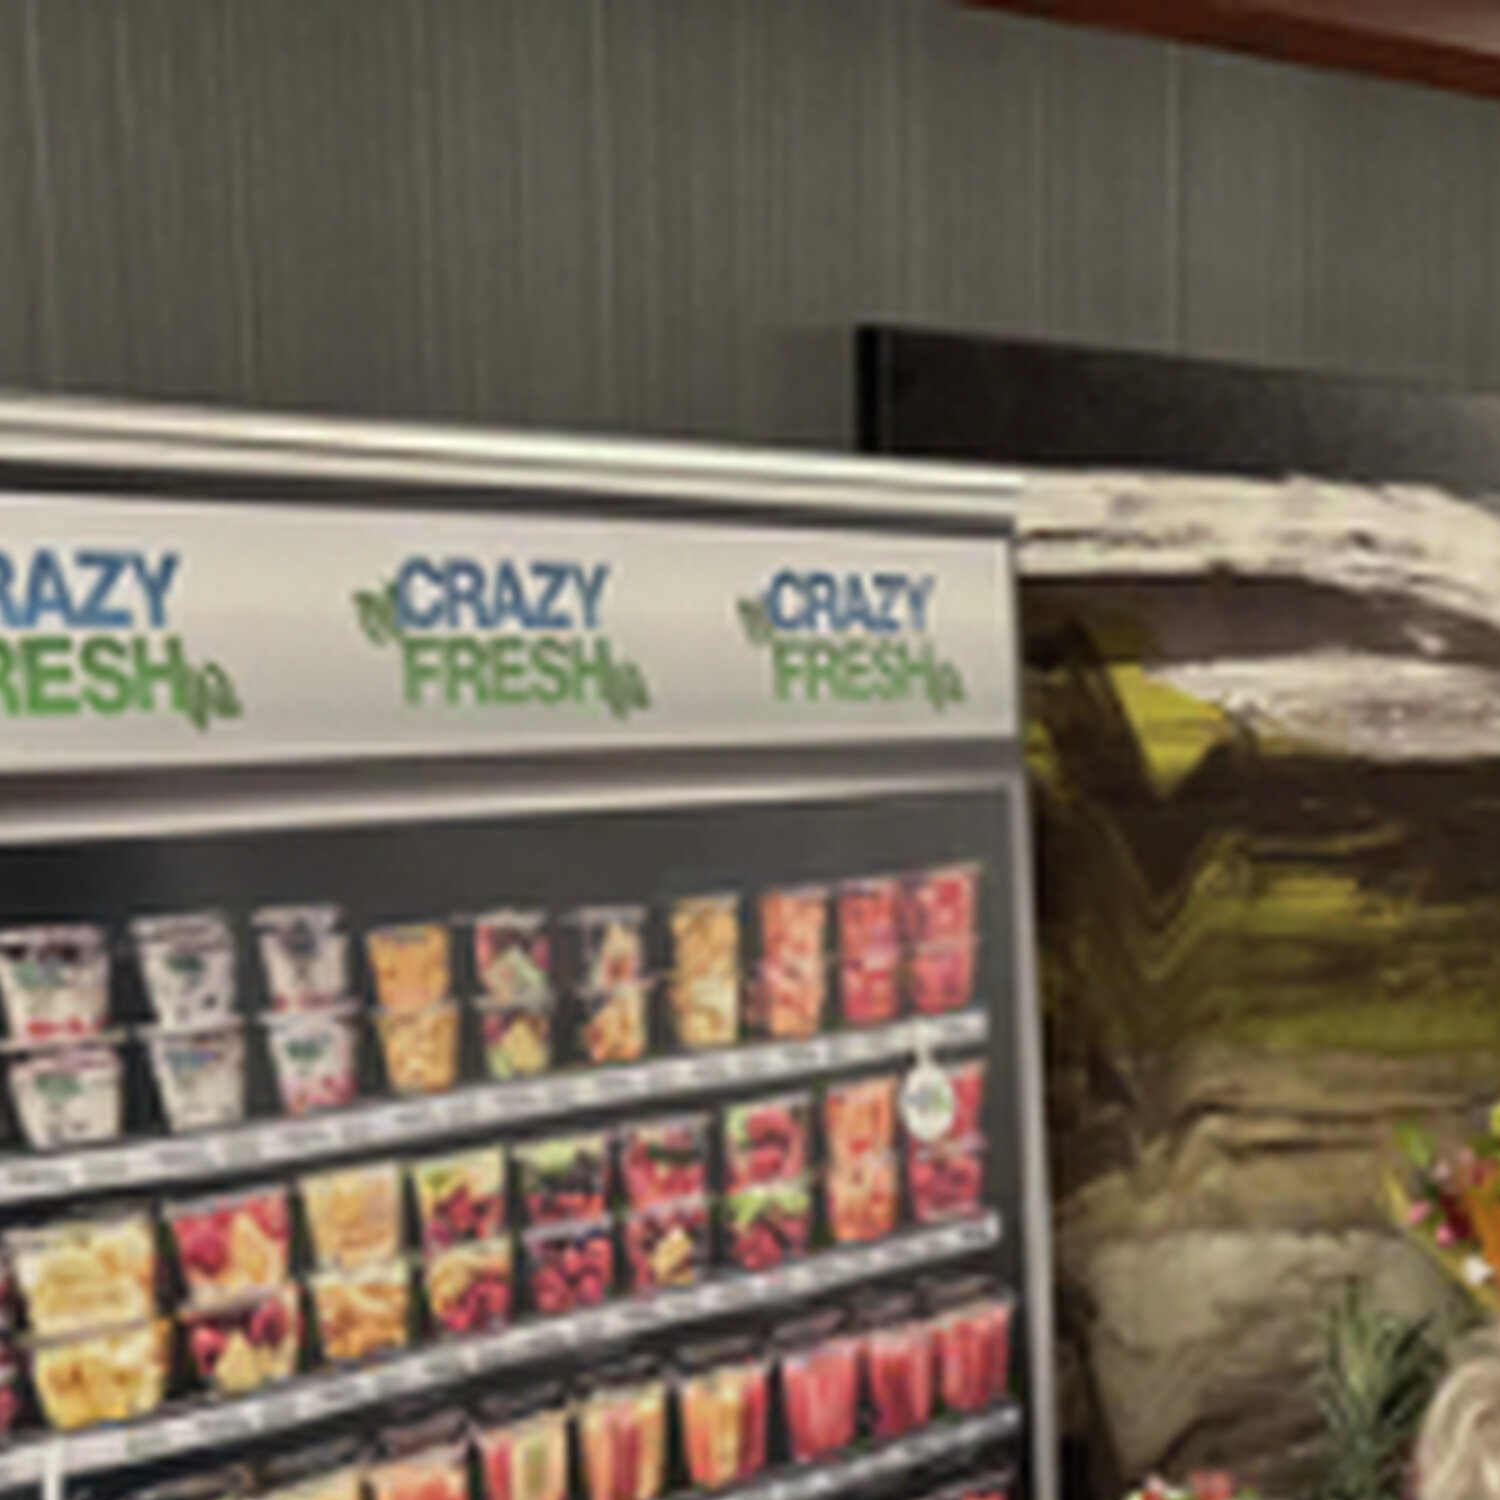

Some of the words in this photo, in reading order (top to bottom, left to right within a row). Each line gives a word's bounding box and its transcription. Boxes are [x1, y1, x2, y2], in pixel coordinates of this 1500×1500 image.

[396, 555, 609, 630] CRAZY
[767, 569, 936, 634] CRAZY
[403, 634, 612, 704] FRESH
[773, 638, 936, 702] FRESH
